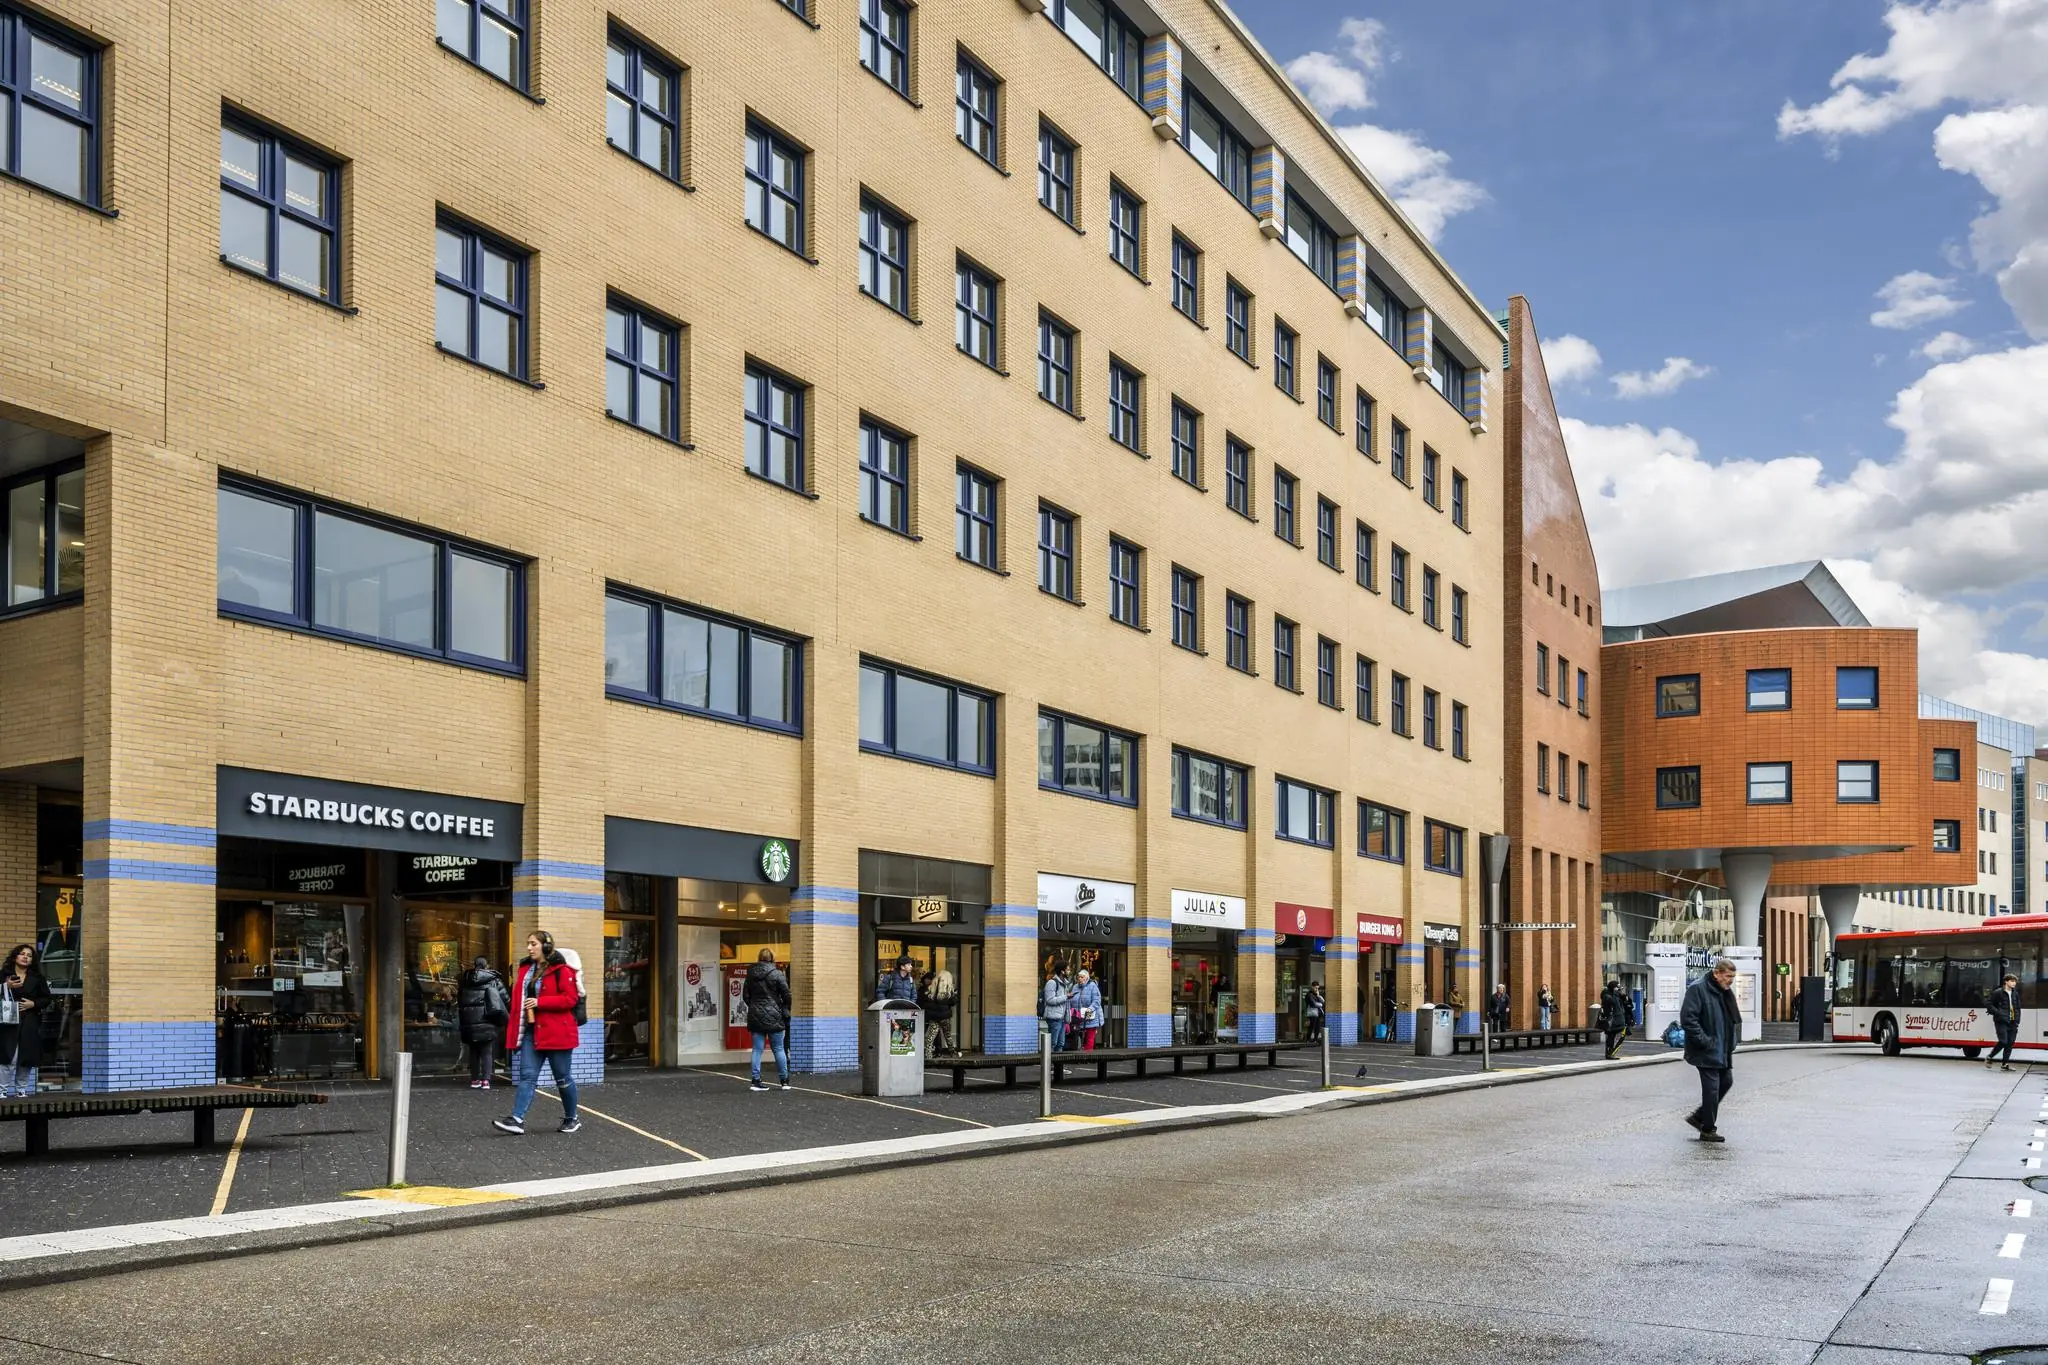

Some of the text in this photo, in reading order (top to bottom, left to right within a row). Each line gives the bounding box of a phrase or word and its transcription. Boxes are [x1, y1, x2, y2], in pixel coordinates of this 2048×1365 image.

[250, 792, 494, 838] STARBUCKS COFFEE
[413, 856, 477, 869] STARBUCKS
[425, 869, 465, 883] COFFEE
[1078, 883, 1096, 903] Etos
[918, 898, 941, 915] Etos
[1184, 898, 1226, 915] JULIA'S
[1042, 912, 1111, 936] JULIA'S
[1360, 921, 1381, 935] BURGER
[1382, 924, 1395, 937] KING
[1905, 1014, 1970, 1031] Syntus Utrecht
